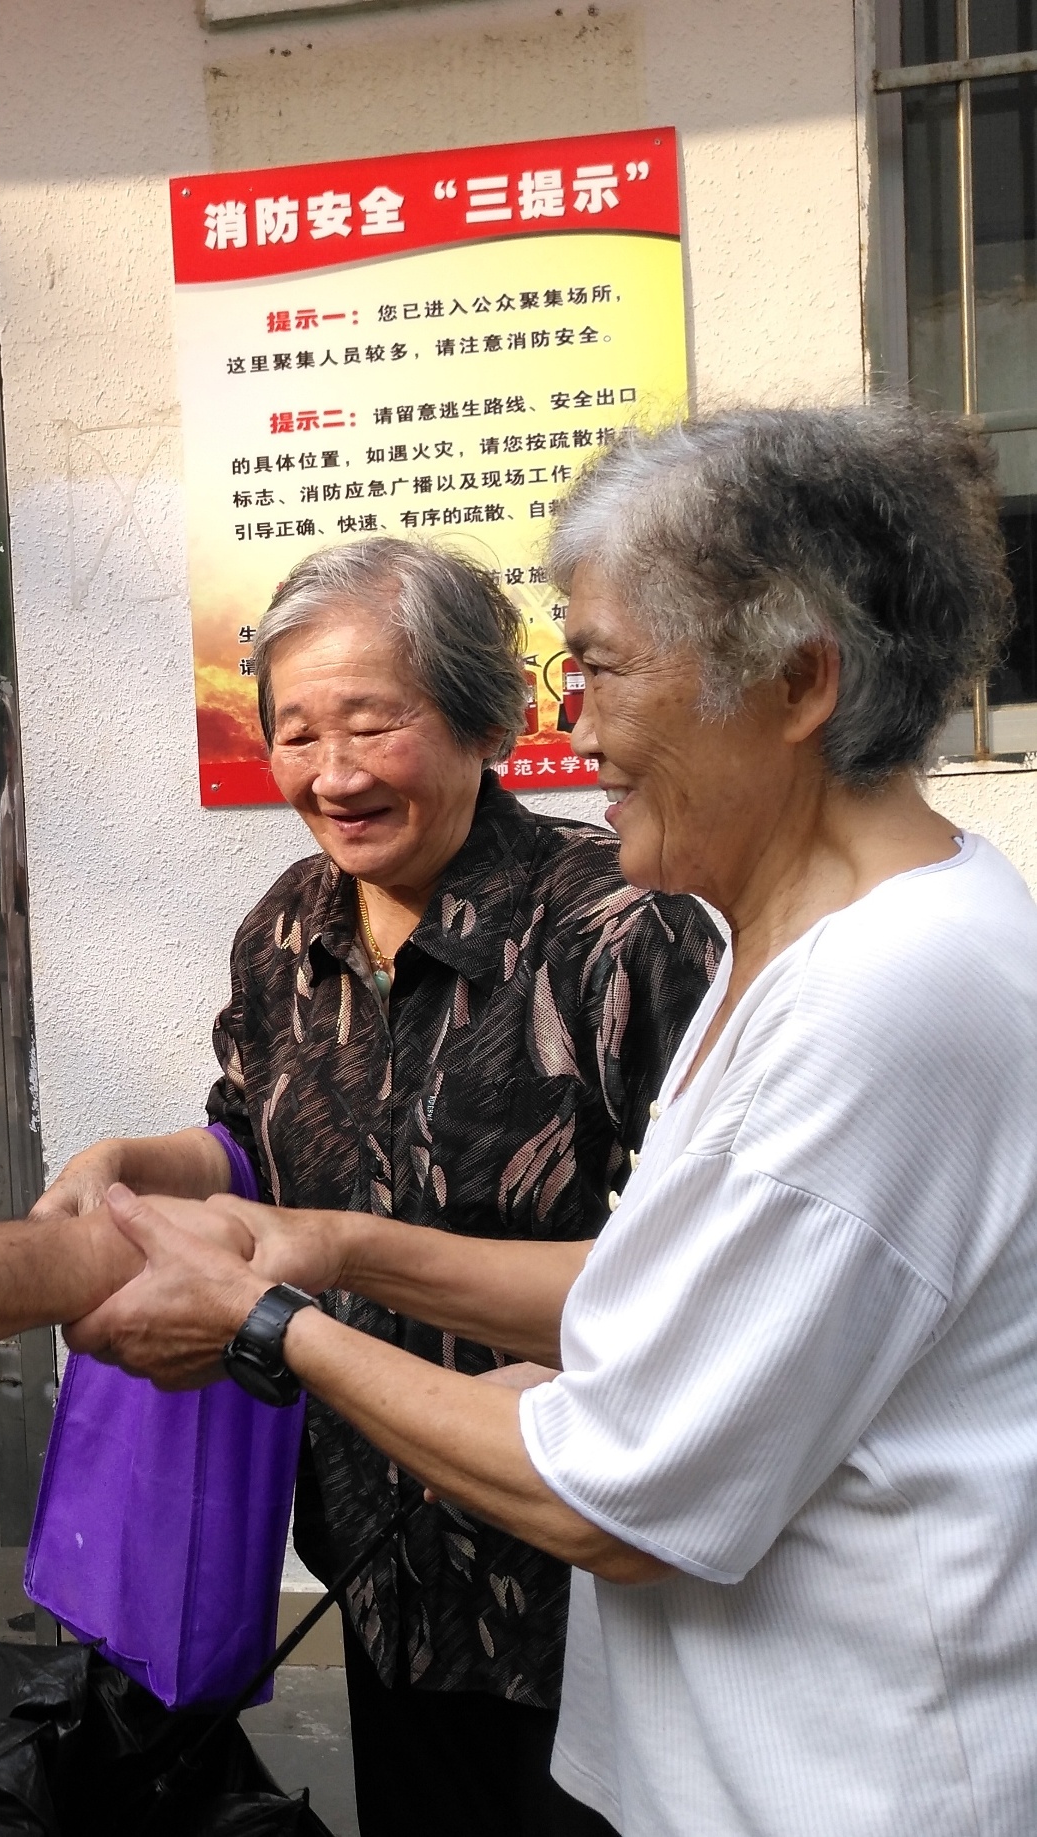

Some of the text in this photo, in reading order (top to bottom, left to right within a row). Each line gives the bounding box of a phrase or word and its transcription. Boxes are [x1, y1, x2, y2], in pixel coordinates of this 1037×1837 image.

[226, 325, 613, 376] 这里聚集人员较多，请注意消防安全。
[231, 426, 638, 475] 的具体位置，如遇火灾，请您按疏散指
[232, 464, 588, 508] 标志、消防应急广播以及现场工作
